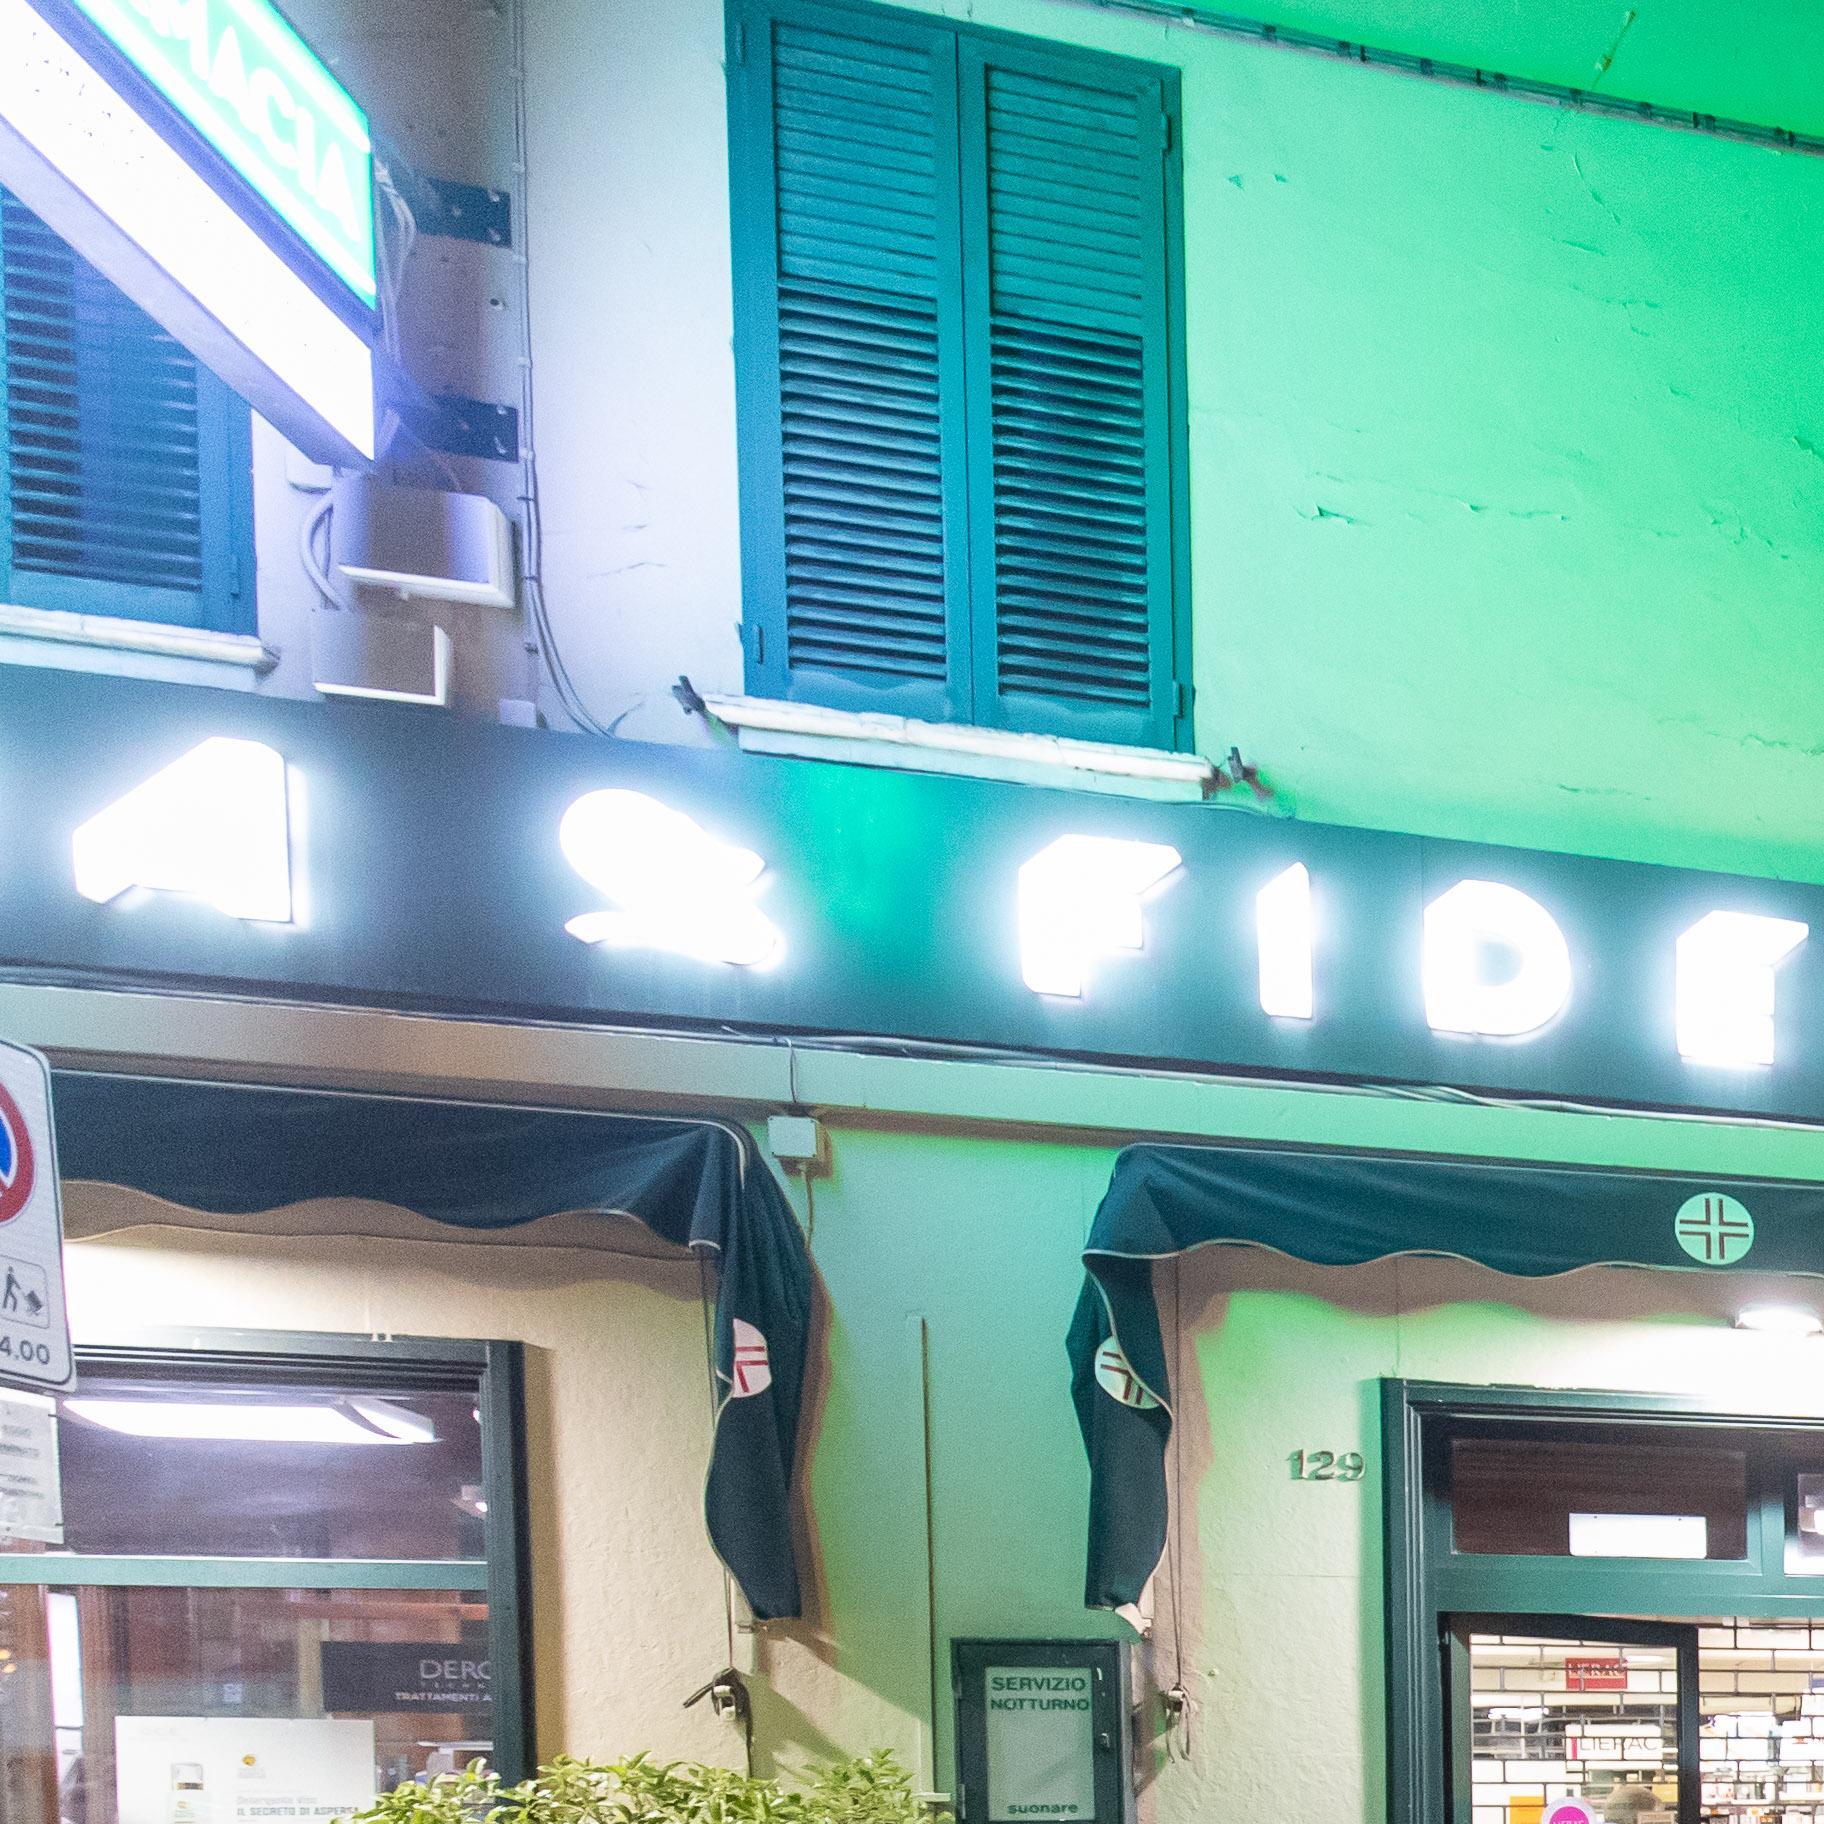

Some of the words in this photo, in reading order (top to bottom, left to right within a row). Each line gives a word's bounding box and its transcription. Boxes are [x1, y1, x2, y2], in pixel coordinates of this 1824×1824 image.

[128, 0, 361, 241] MACIA
[1285, 1449, 1365, 1482] 129
[419, 1659, 492, 1680] DERC
[990, 1677, 1087, 1692] SERVIZIO
[990, 1698, 1090, 1711] NOTTURNO
[1579, 1737, 1657, 1751] LIERAC
[1007, 1803, 1079, 1815] suonare
